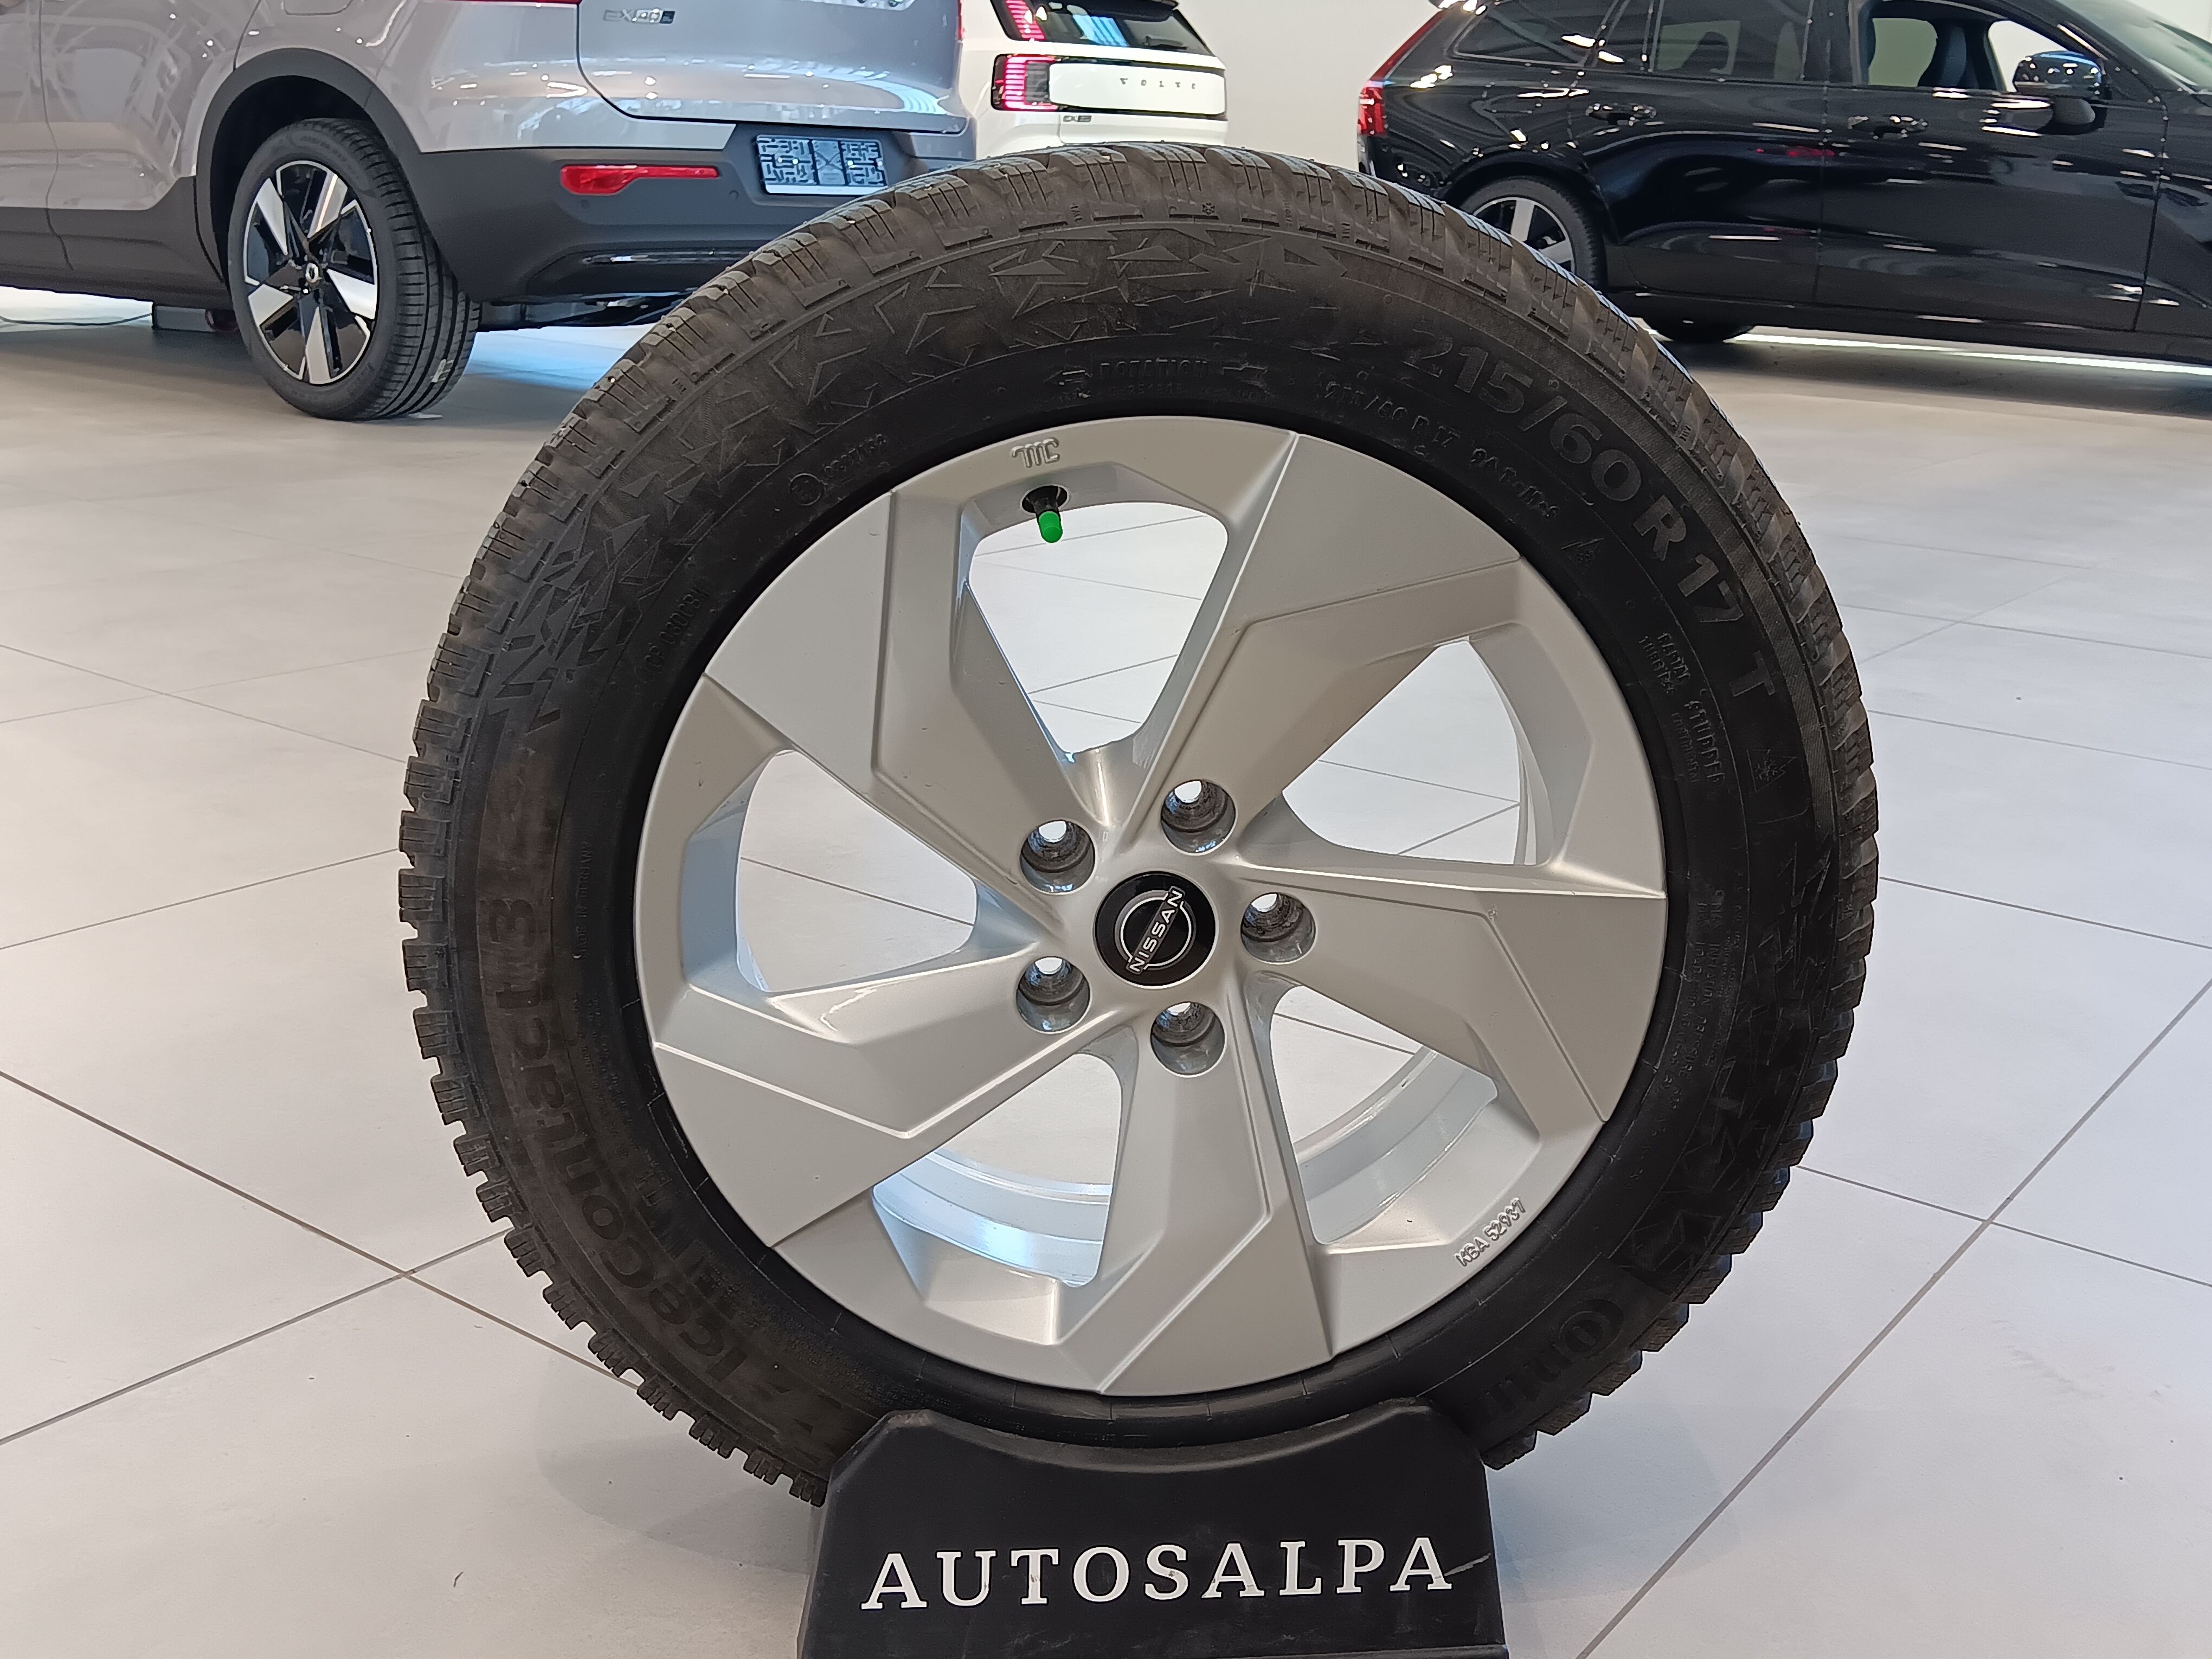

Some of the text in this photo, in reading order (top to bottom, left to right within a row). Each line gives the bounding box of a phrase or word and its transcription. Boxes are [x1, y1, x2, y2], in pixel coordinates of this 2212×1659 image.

[1402, 329, 1776, 698] 215/60 R 17 T
[1129, 890, 1184, 973] NISSAN
[1454, 1197, 1526, 1267] KBA 52937
[860, 1535, 1454, 1612] AUTOSALPA
